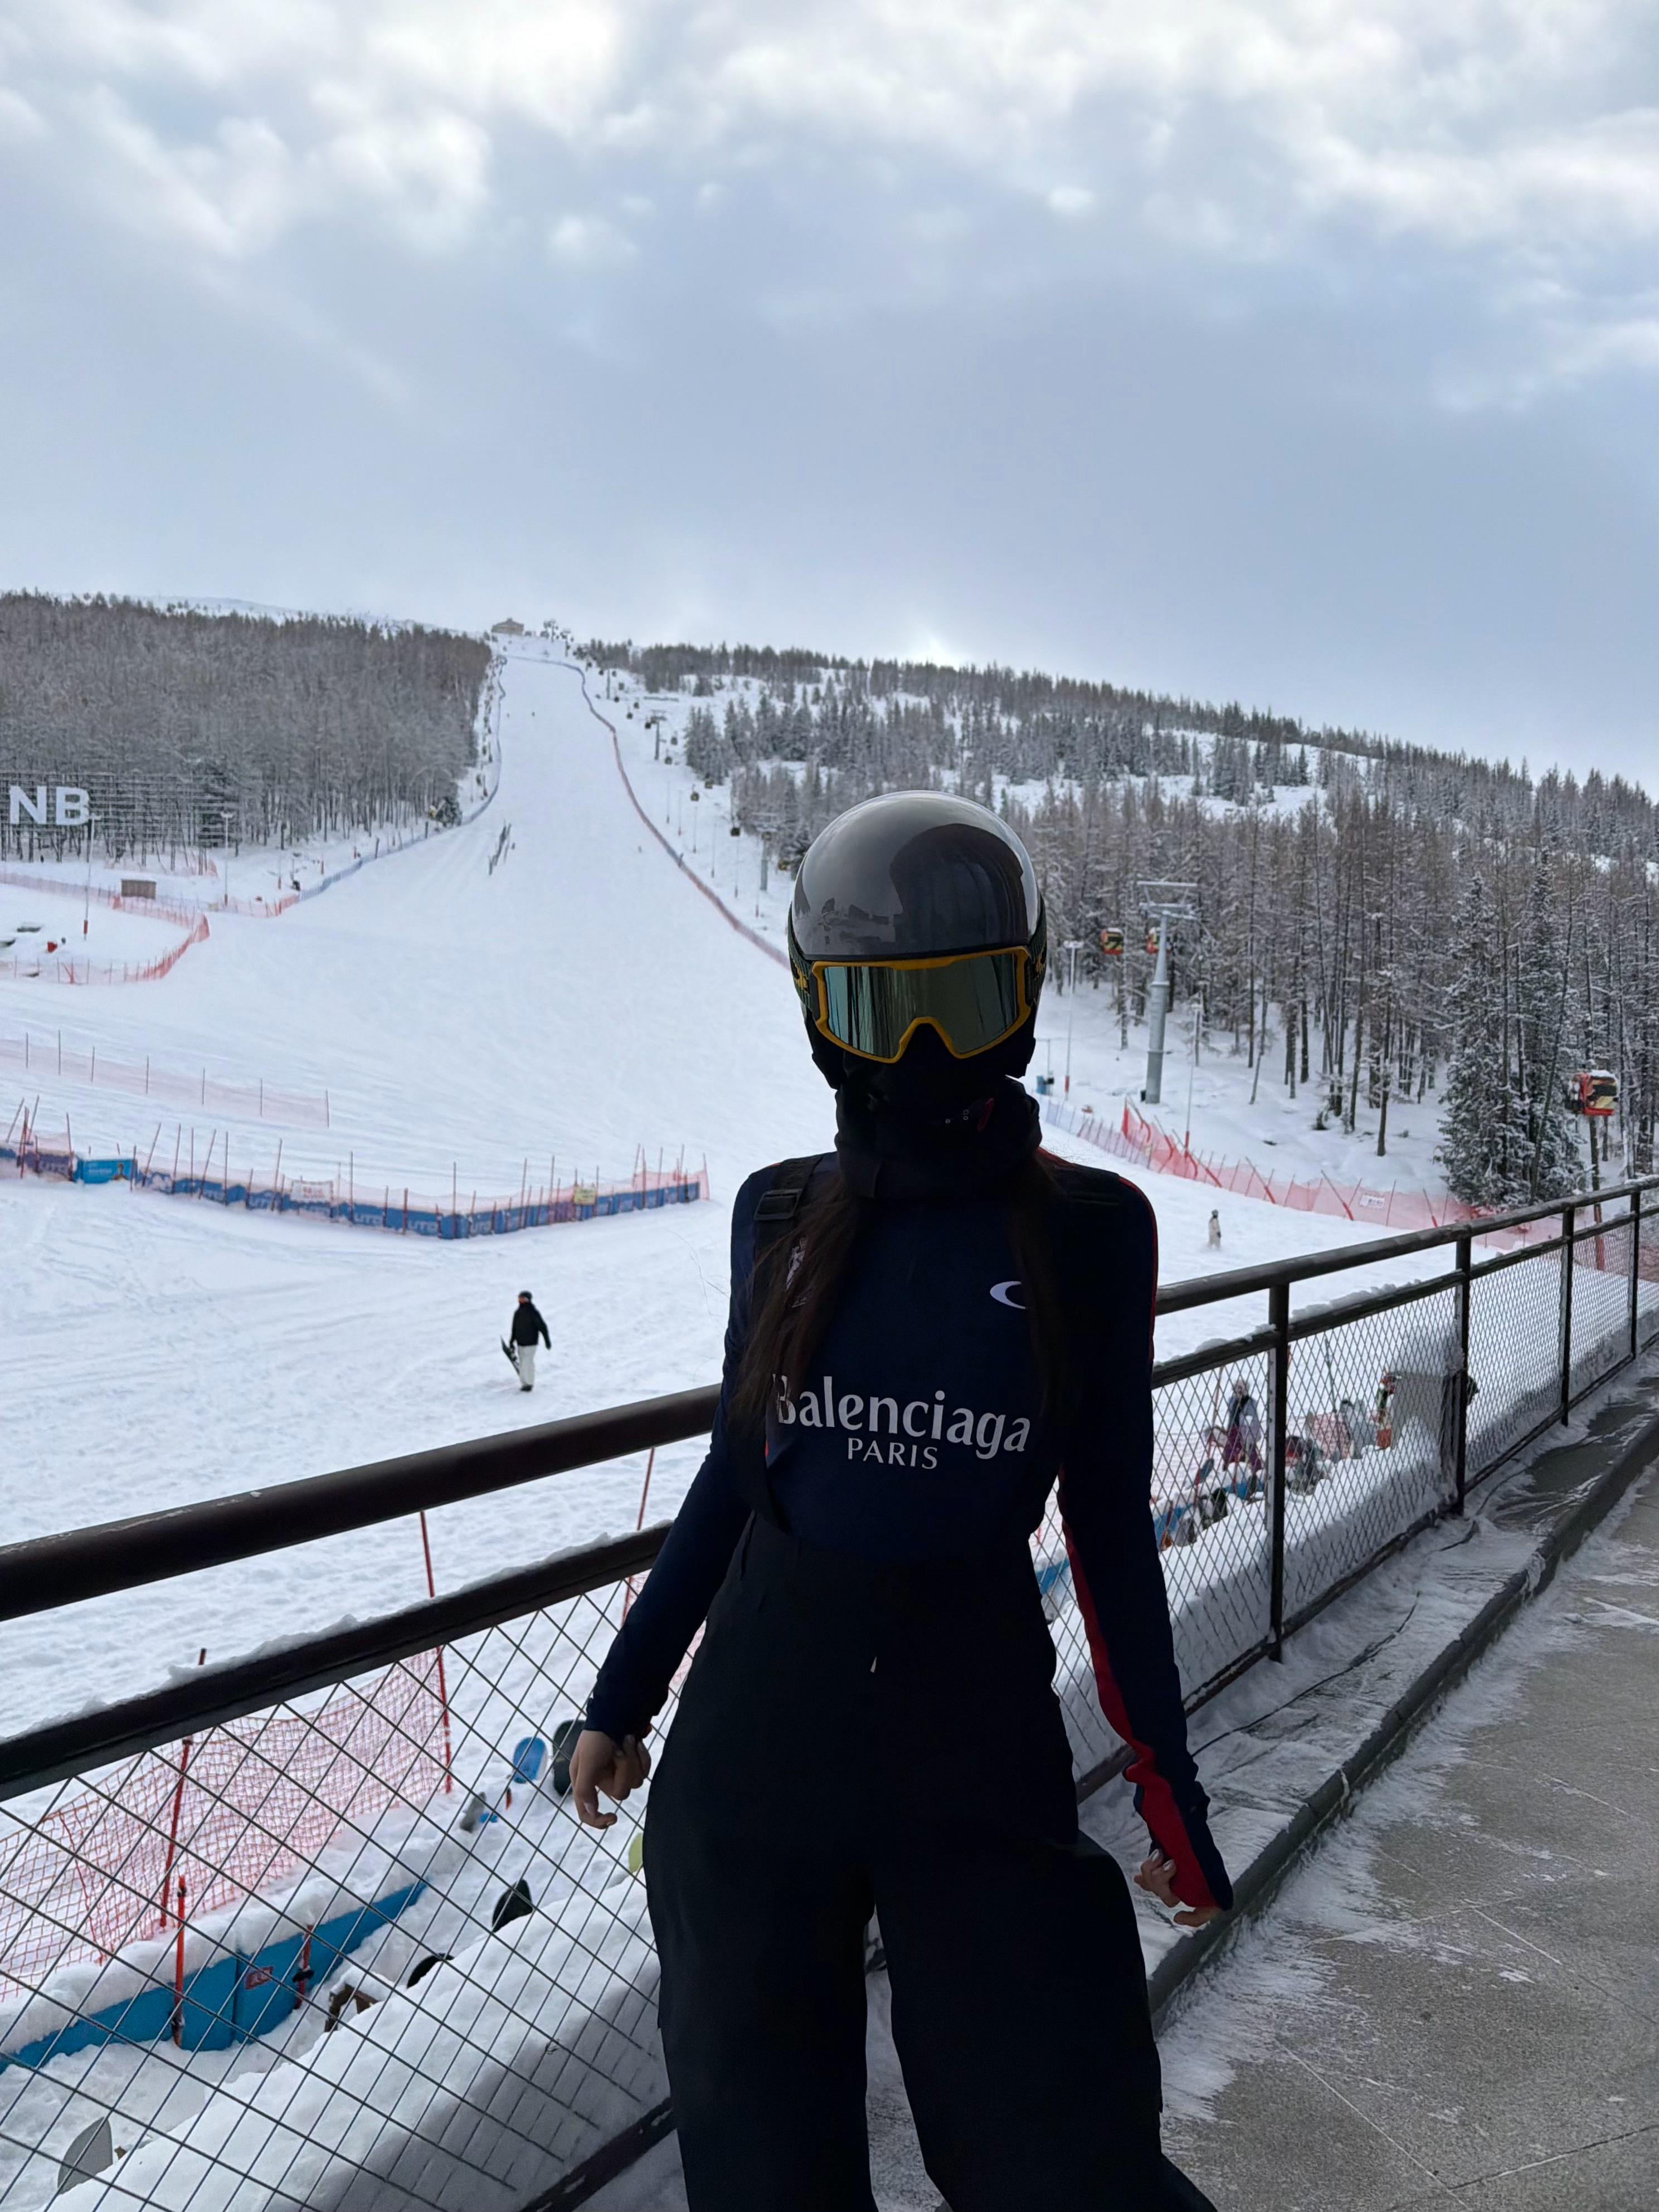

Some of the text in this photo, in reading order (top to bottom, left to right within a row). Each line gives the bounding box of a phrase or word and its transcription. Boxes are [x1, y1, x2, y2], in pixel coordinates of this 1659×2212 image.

[9, 785, 90, 825] NB
[772, 1373, 1030, 1460] Balenciaga
[847, 1437, 938, 1469] PARIS
